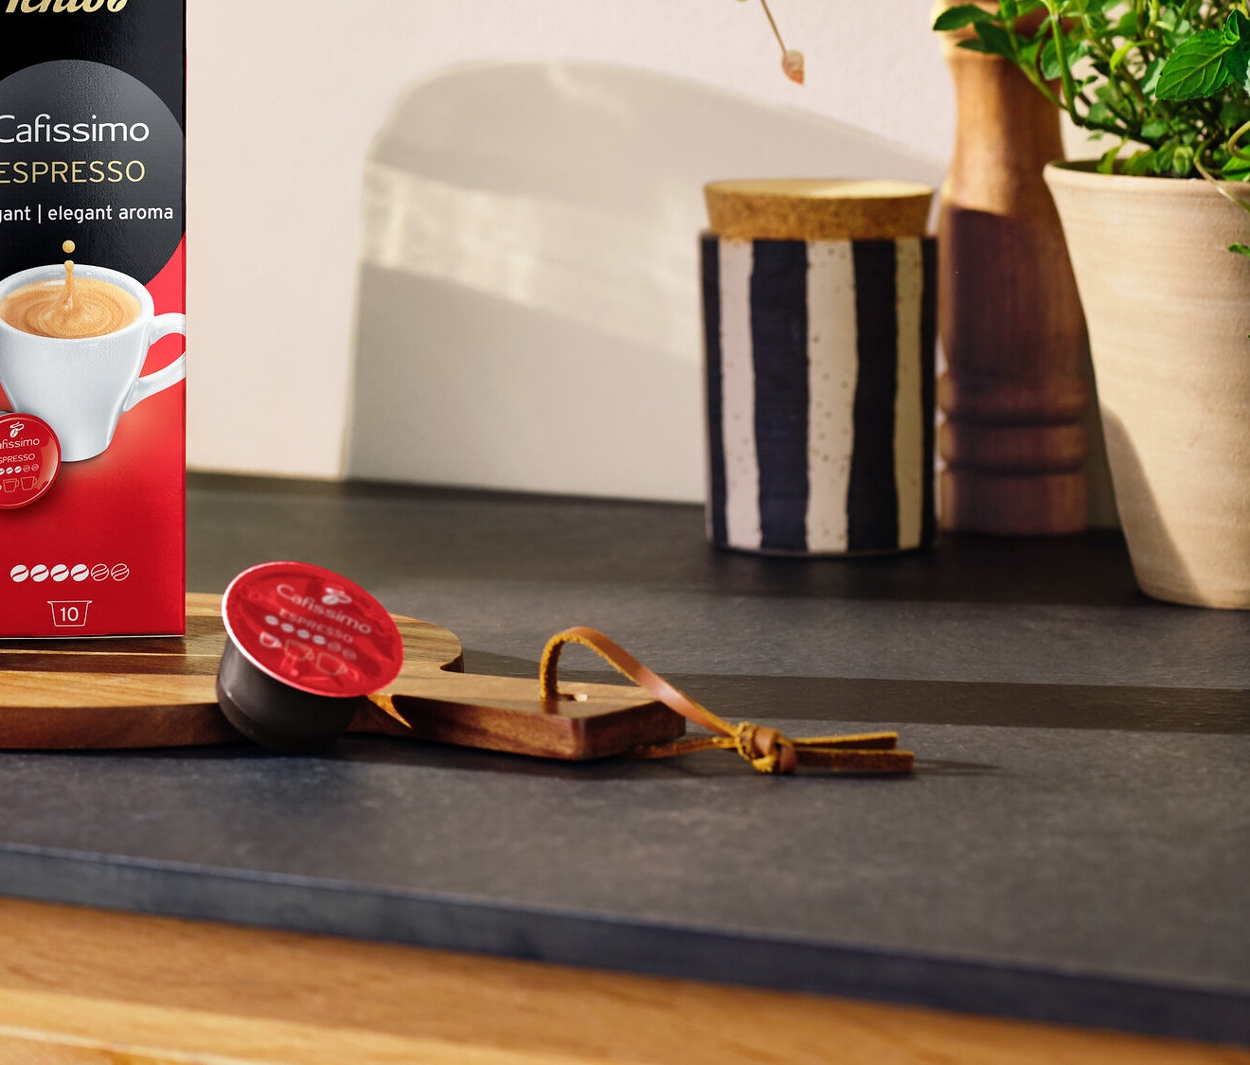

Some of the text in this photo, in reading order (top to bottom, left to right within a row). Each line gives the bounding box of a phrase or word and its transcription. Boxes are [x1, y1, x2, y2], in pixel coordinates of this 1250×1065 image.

[47, 205, 112, 223] elegant
[118, 206, 174, 220] aroma
[60, 607, 79, 621] 10
[276, 584, 372, 634] Cafissimo
[279, 608, 353, 643] ESPRESSO
